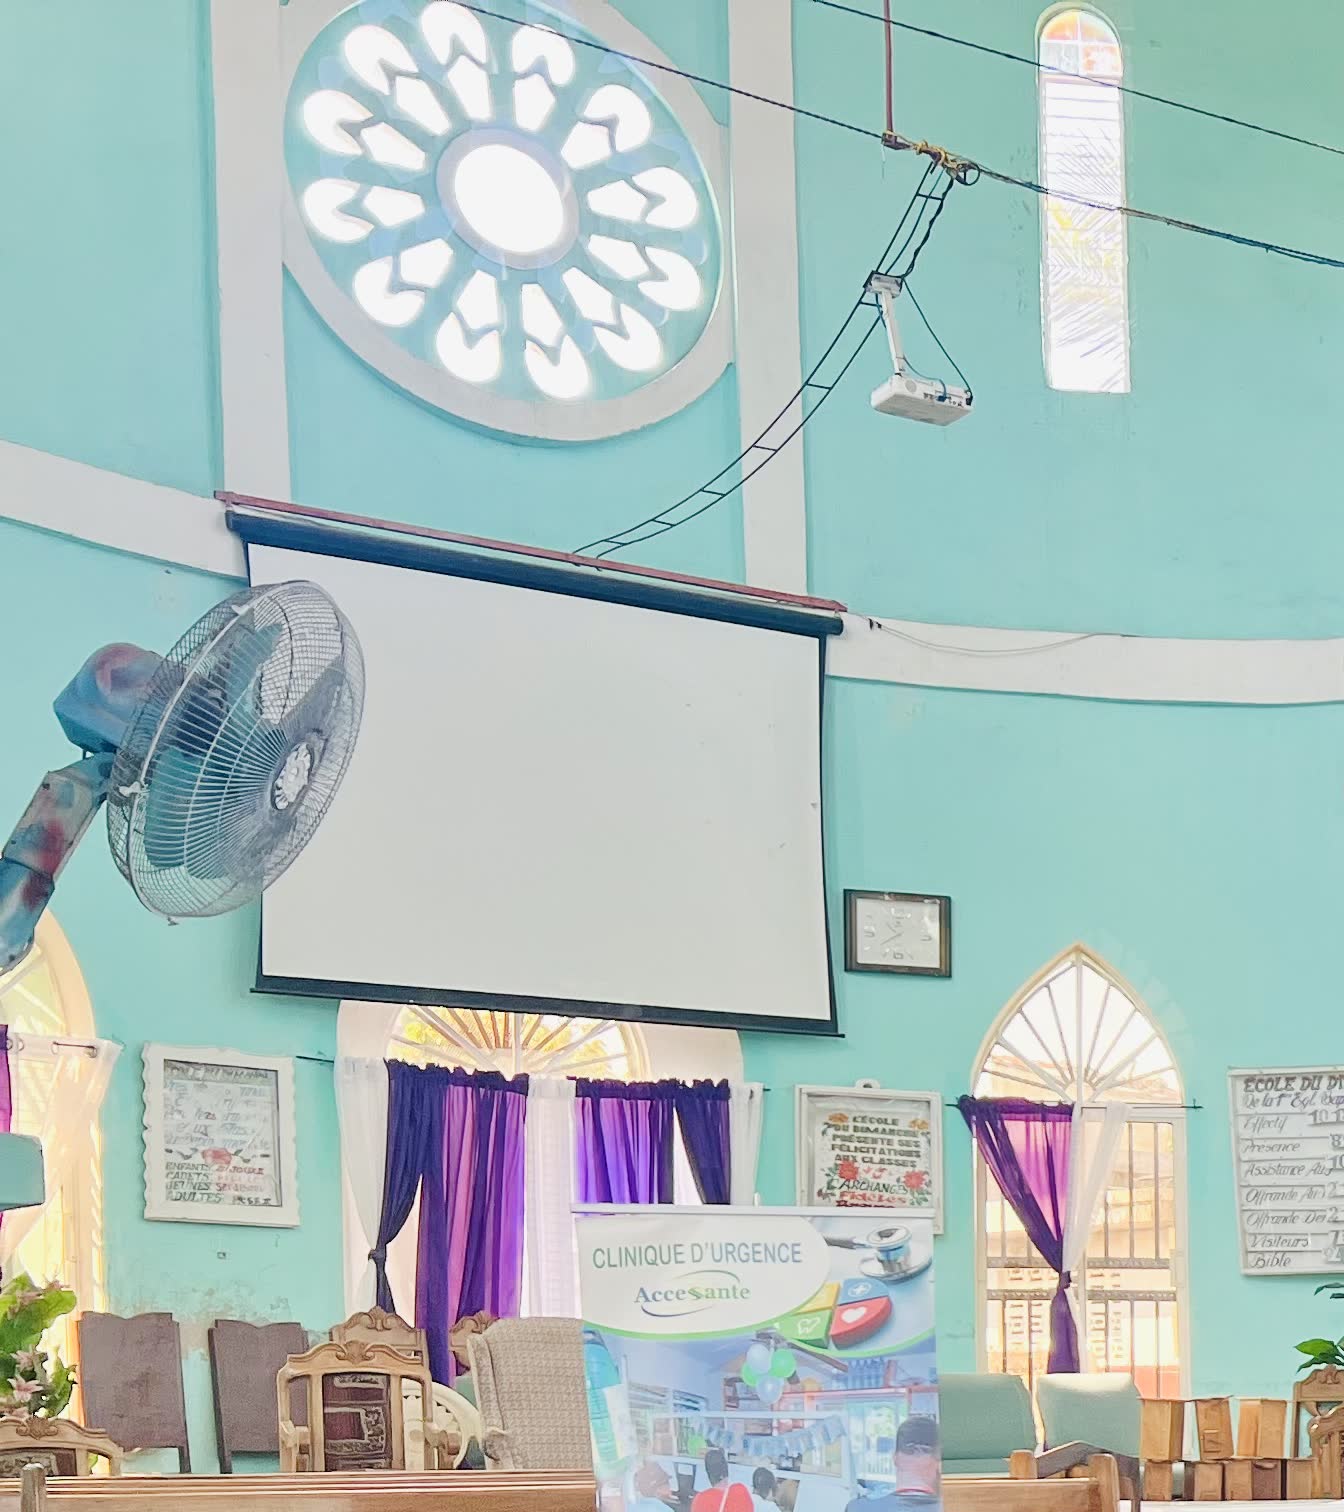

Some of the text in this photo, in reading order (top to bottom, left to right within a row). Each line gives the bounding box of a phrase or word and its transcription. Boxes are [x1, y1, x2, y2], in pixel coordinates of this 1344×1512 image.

[1300, 1074, 1322, 1091] DU
[861, 1156, 917, 1168] CLASSES
[592, 1241, 803, 1269] CLINIQUE D'URGENCE
[1251, 1251, 1292, 1269] Bible
